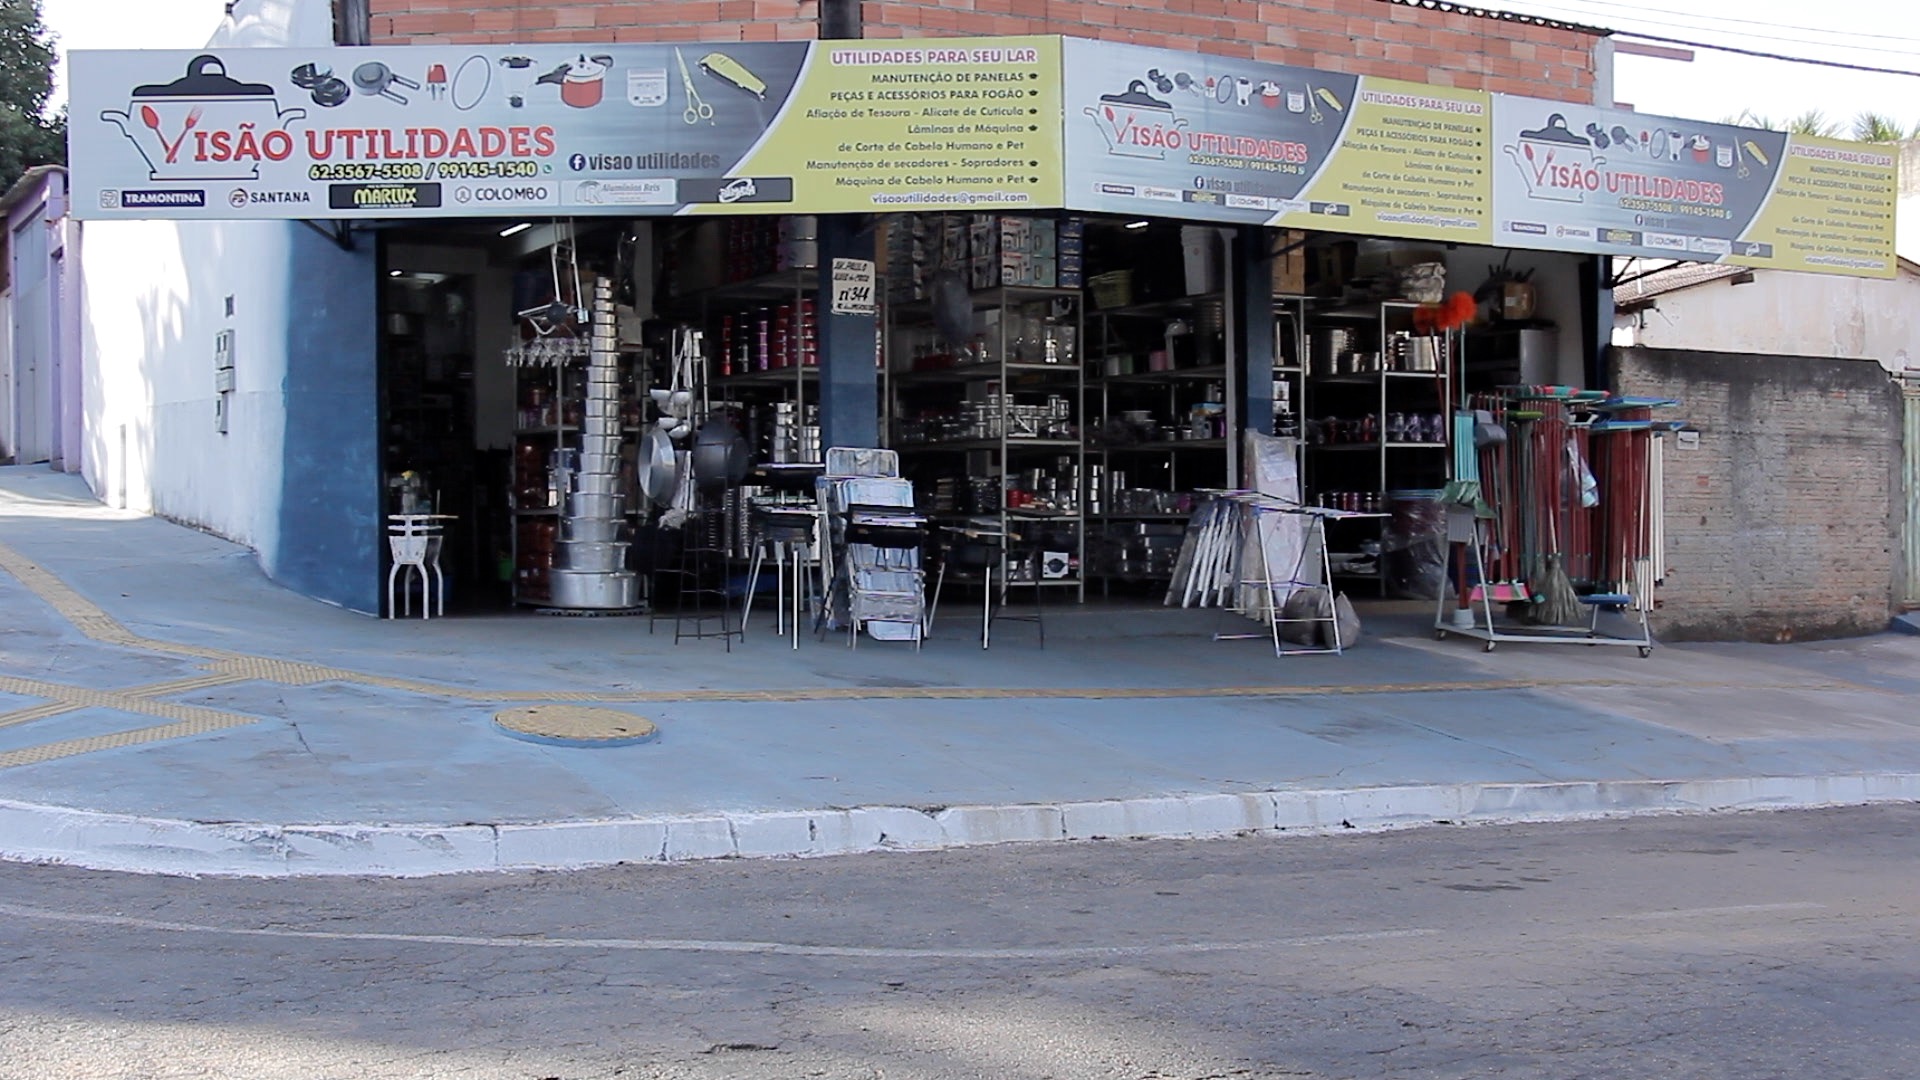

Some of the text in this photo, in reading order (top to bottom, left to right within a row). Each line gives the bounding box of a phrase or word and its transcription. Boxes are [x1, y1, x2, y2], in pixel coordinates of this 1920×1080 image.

[832, 50, 1036, 64] UTILIDADES PARA SEU LAR
[871, 71, 1024, 84] MANUTENÇÃO DE PANELAS
[831, 88, 1024, 102] PEÇAS E ACESSÓRIOS PARA FOGÃO
[1362, 92, 1482, 114] UTILIDADES PARA SEU LAR
[851, 109, 864, 117] de
[868, 108, 911, 117] Tesoura
[922, 107, 960, 116] Alicate
[963, 107, 977, 116] de
[957, 124, 971, 133] de
[305, 126, 555, 160] UTILIDADES
[838, 143, 852, 151] de
[855, 142, 884, 151] Corte
[887, 142, 901, 151] de
[904, 142, 943, 151] Cabelo
[946, 142, 993, 150] Humano
[1006, 141, 1024, 149] Pet
[1188, 133, 1308, 162] UTILIDADES
[589, 153, 720, 170] visao utilidades
[877, 159, 891, 168] de
[894, 158, 949, 168] secadores
[960, 158, 1024, 169] Sopradores
[309, 163, 422, 180] 62.3567-5508
[438, 162, 538, 177] 99145-1540
[887, 176, 901, 185] de
[904, 175, 943, 185] Cabelo
[946, 175, 993, 184] Humano
[1007, 175, 1024, 183] Pet
[475, 188, 548, 200] COLOMBO
[1605, 173, 1723, 204] UTILIDADES
[125, 193, 201, 204] TRAMONTINA
[251, 192, 310, 203] SANTANA
[354, 188, 417, 204] MARLUX
[872, 193, 1028, 203] visaoutilidades@gmail.com
